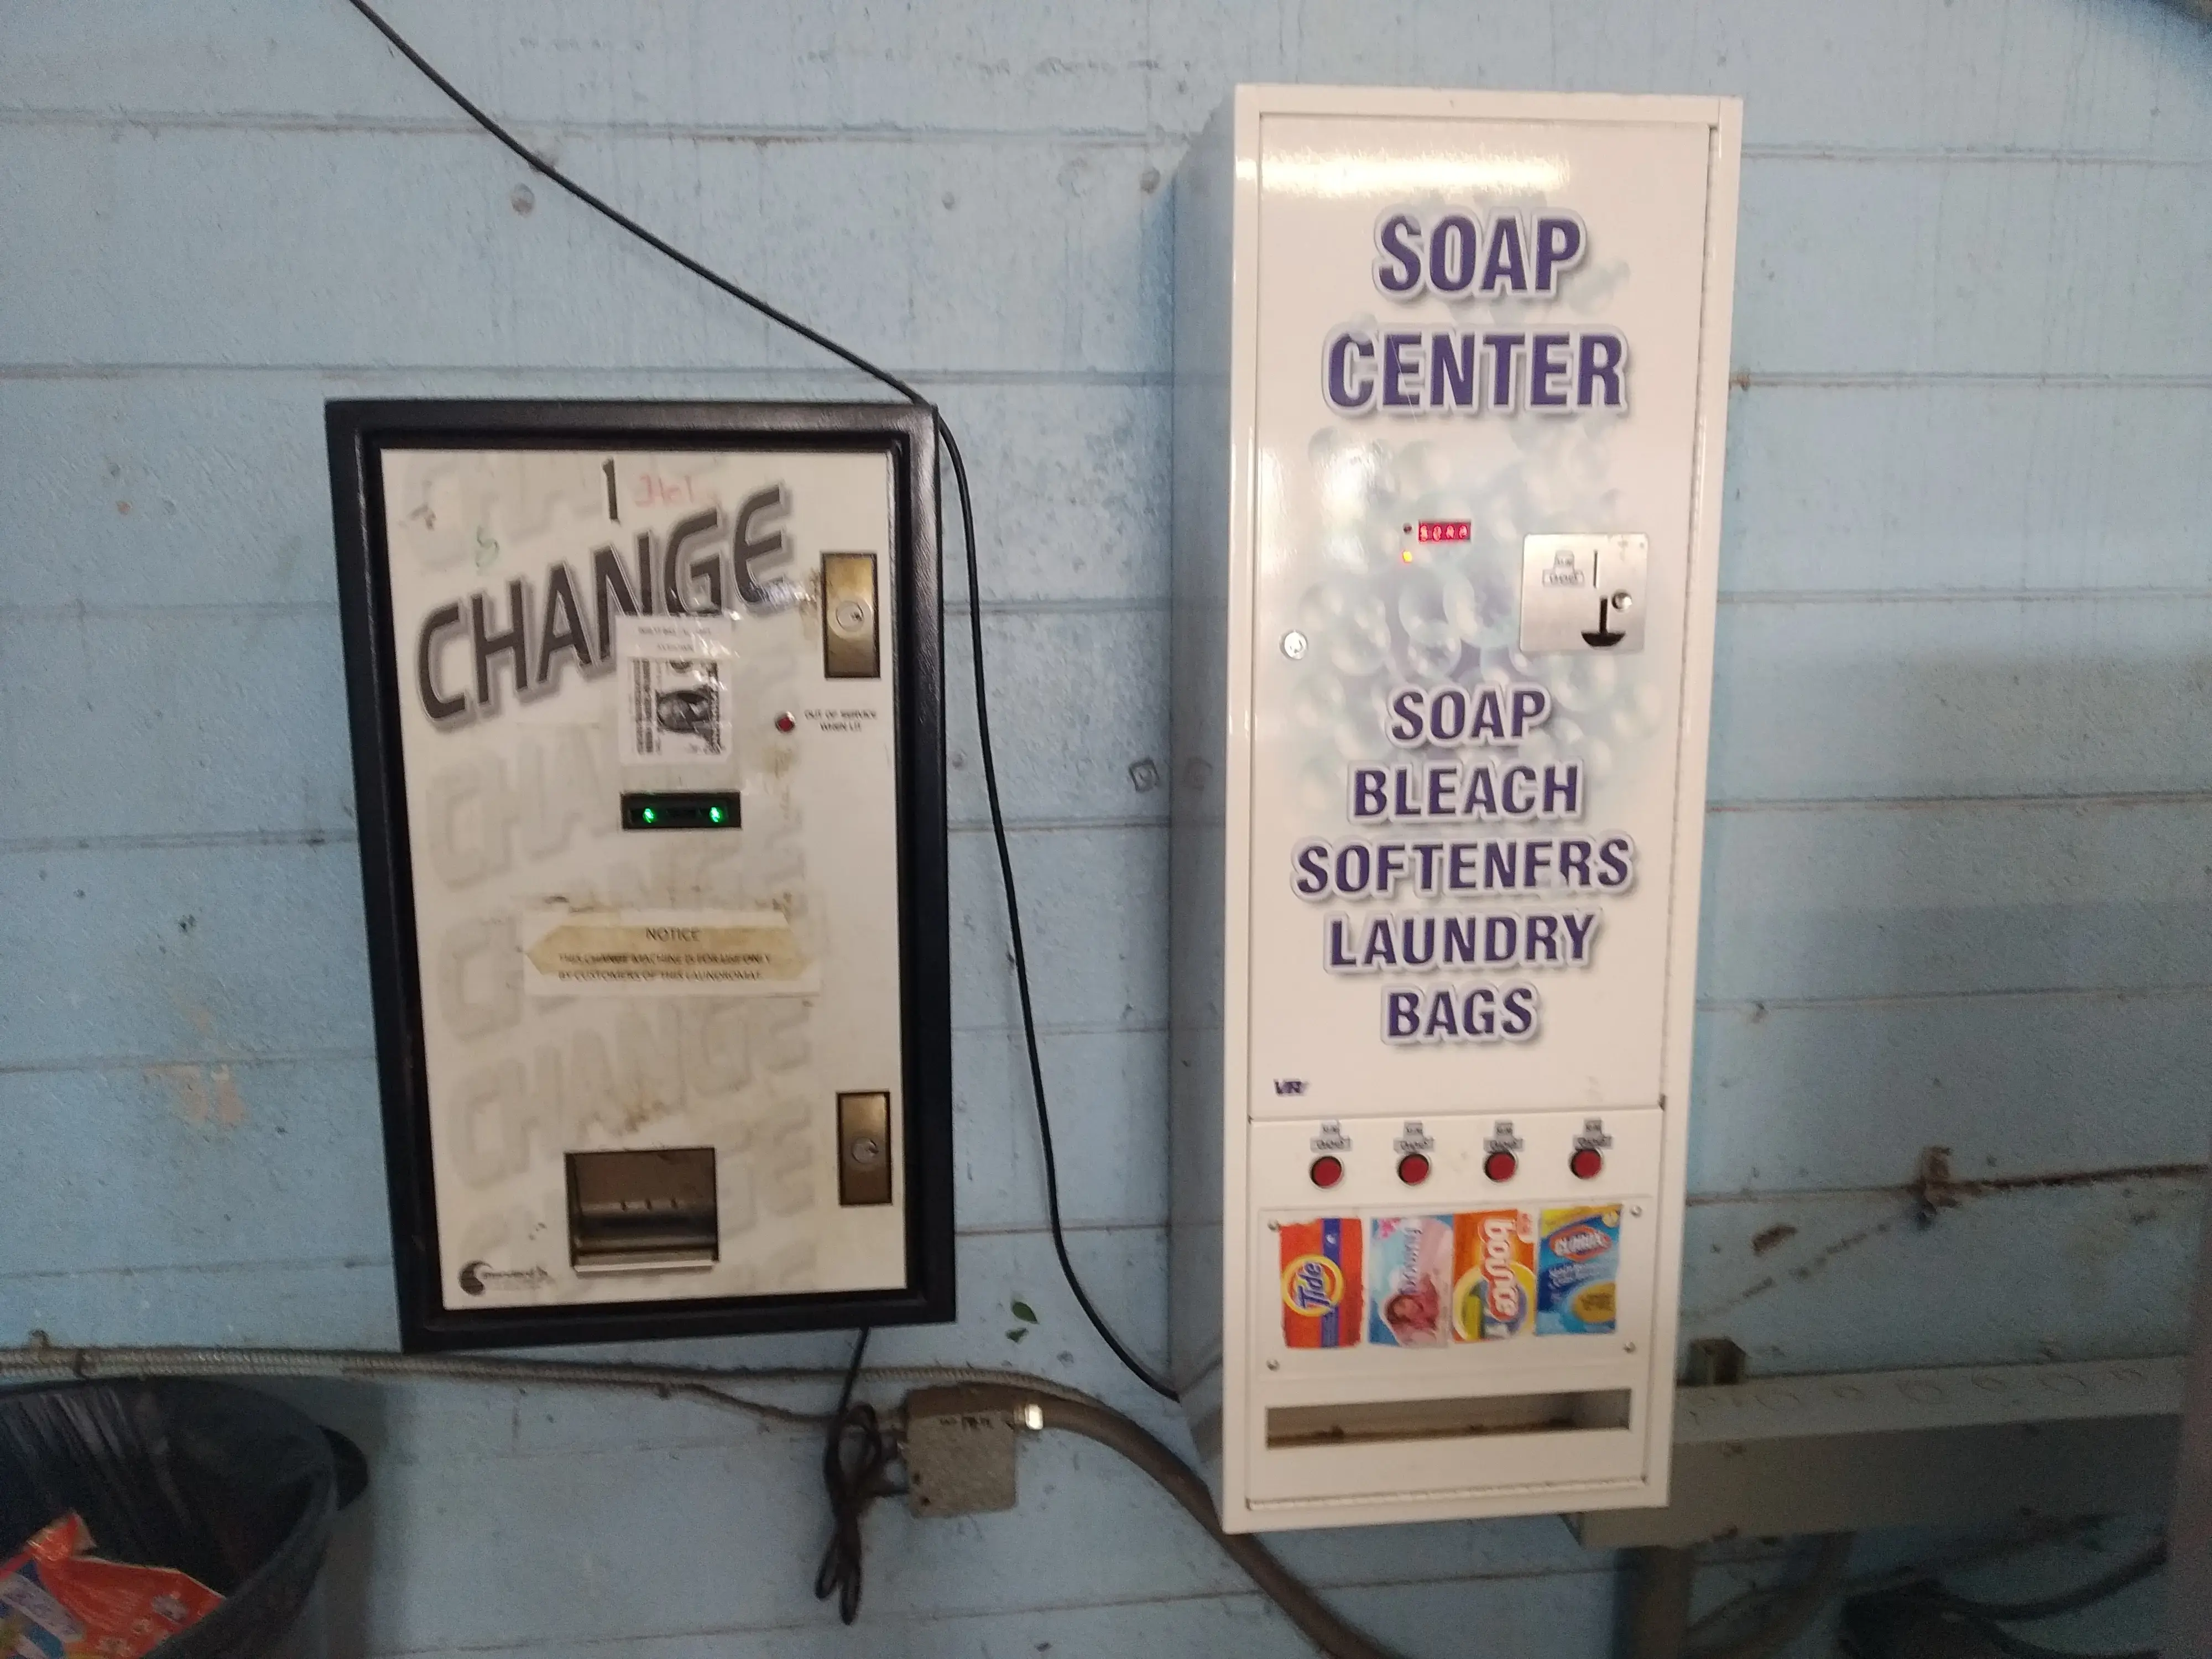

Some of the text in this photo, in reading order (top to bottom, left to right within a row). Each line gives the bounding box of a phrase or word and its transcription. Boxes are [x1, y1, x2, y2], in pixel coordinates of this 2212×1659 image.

[1378, 213, 1582, 293] SOAP
[1327, 331, 1624, 408] CENTER
[416, 483, 785, 722] CHANGE
[1390, 688, 1546, 742] SOAP
[1354, 763, 1579, 817] BLEACH
[1295, 837, 1630, 894] SOFTENERS
[646, 927, 702, 942] NOTICE
[1329, 913, 1596, 967] LAUNDRY
[1387, 987, 1533, 1037] BAGS
[1297, 1262, 1331, 1308] Tide
